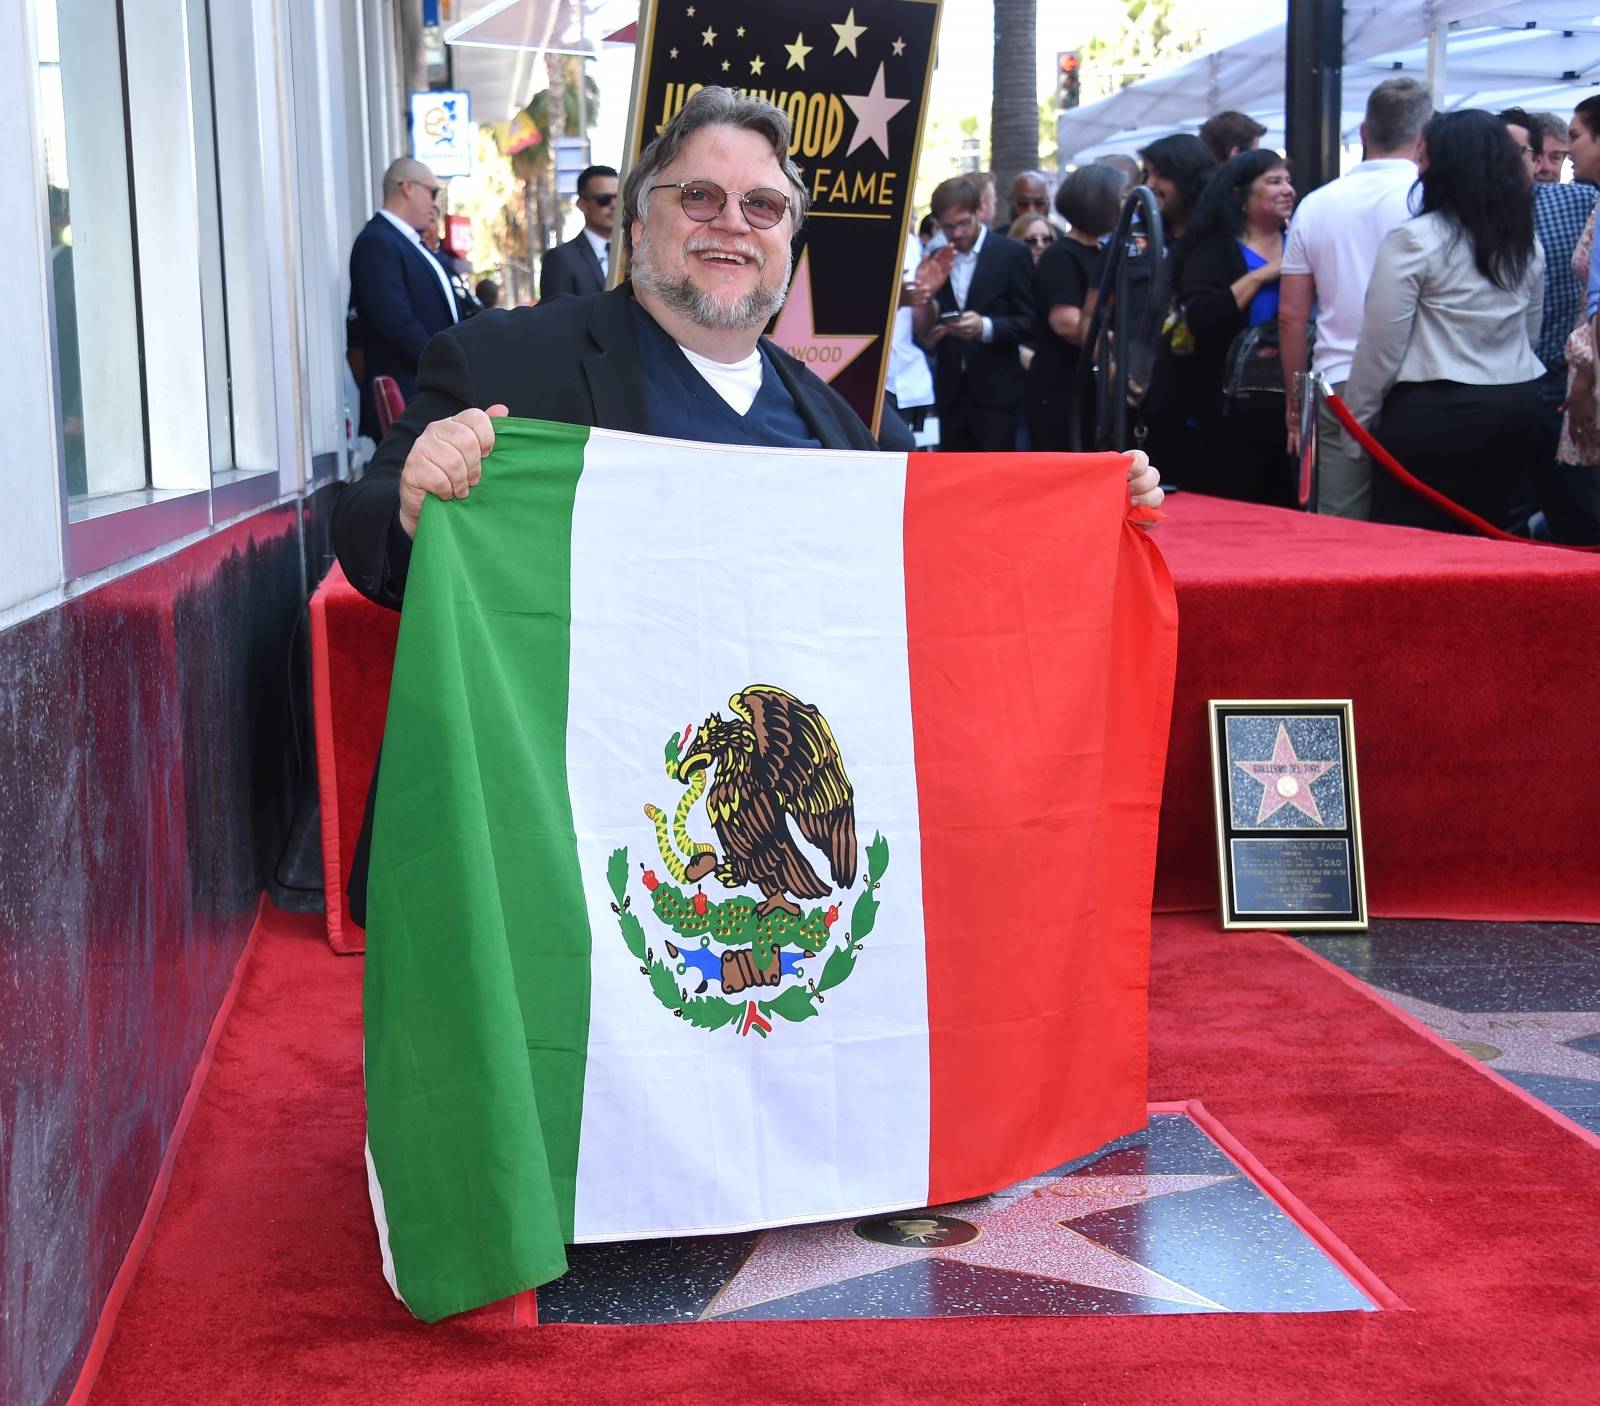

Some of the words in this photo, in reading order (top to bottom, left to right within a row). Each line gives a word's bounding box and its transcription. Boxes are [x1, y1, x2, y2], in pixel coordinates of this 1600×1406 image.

[812, 168, 897, 206] FAME
[788, 346, 843, 363] WOOD
[1019, 1184, 1148, 1199] TORO
